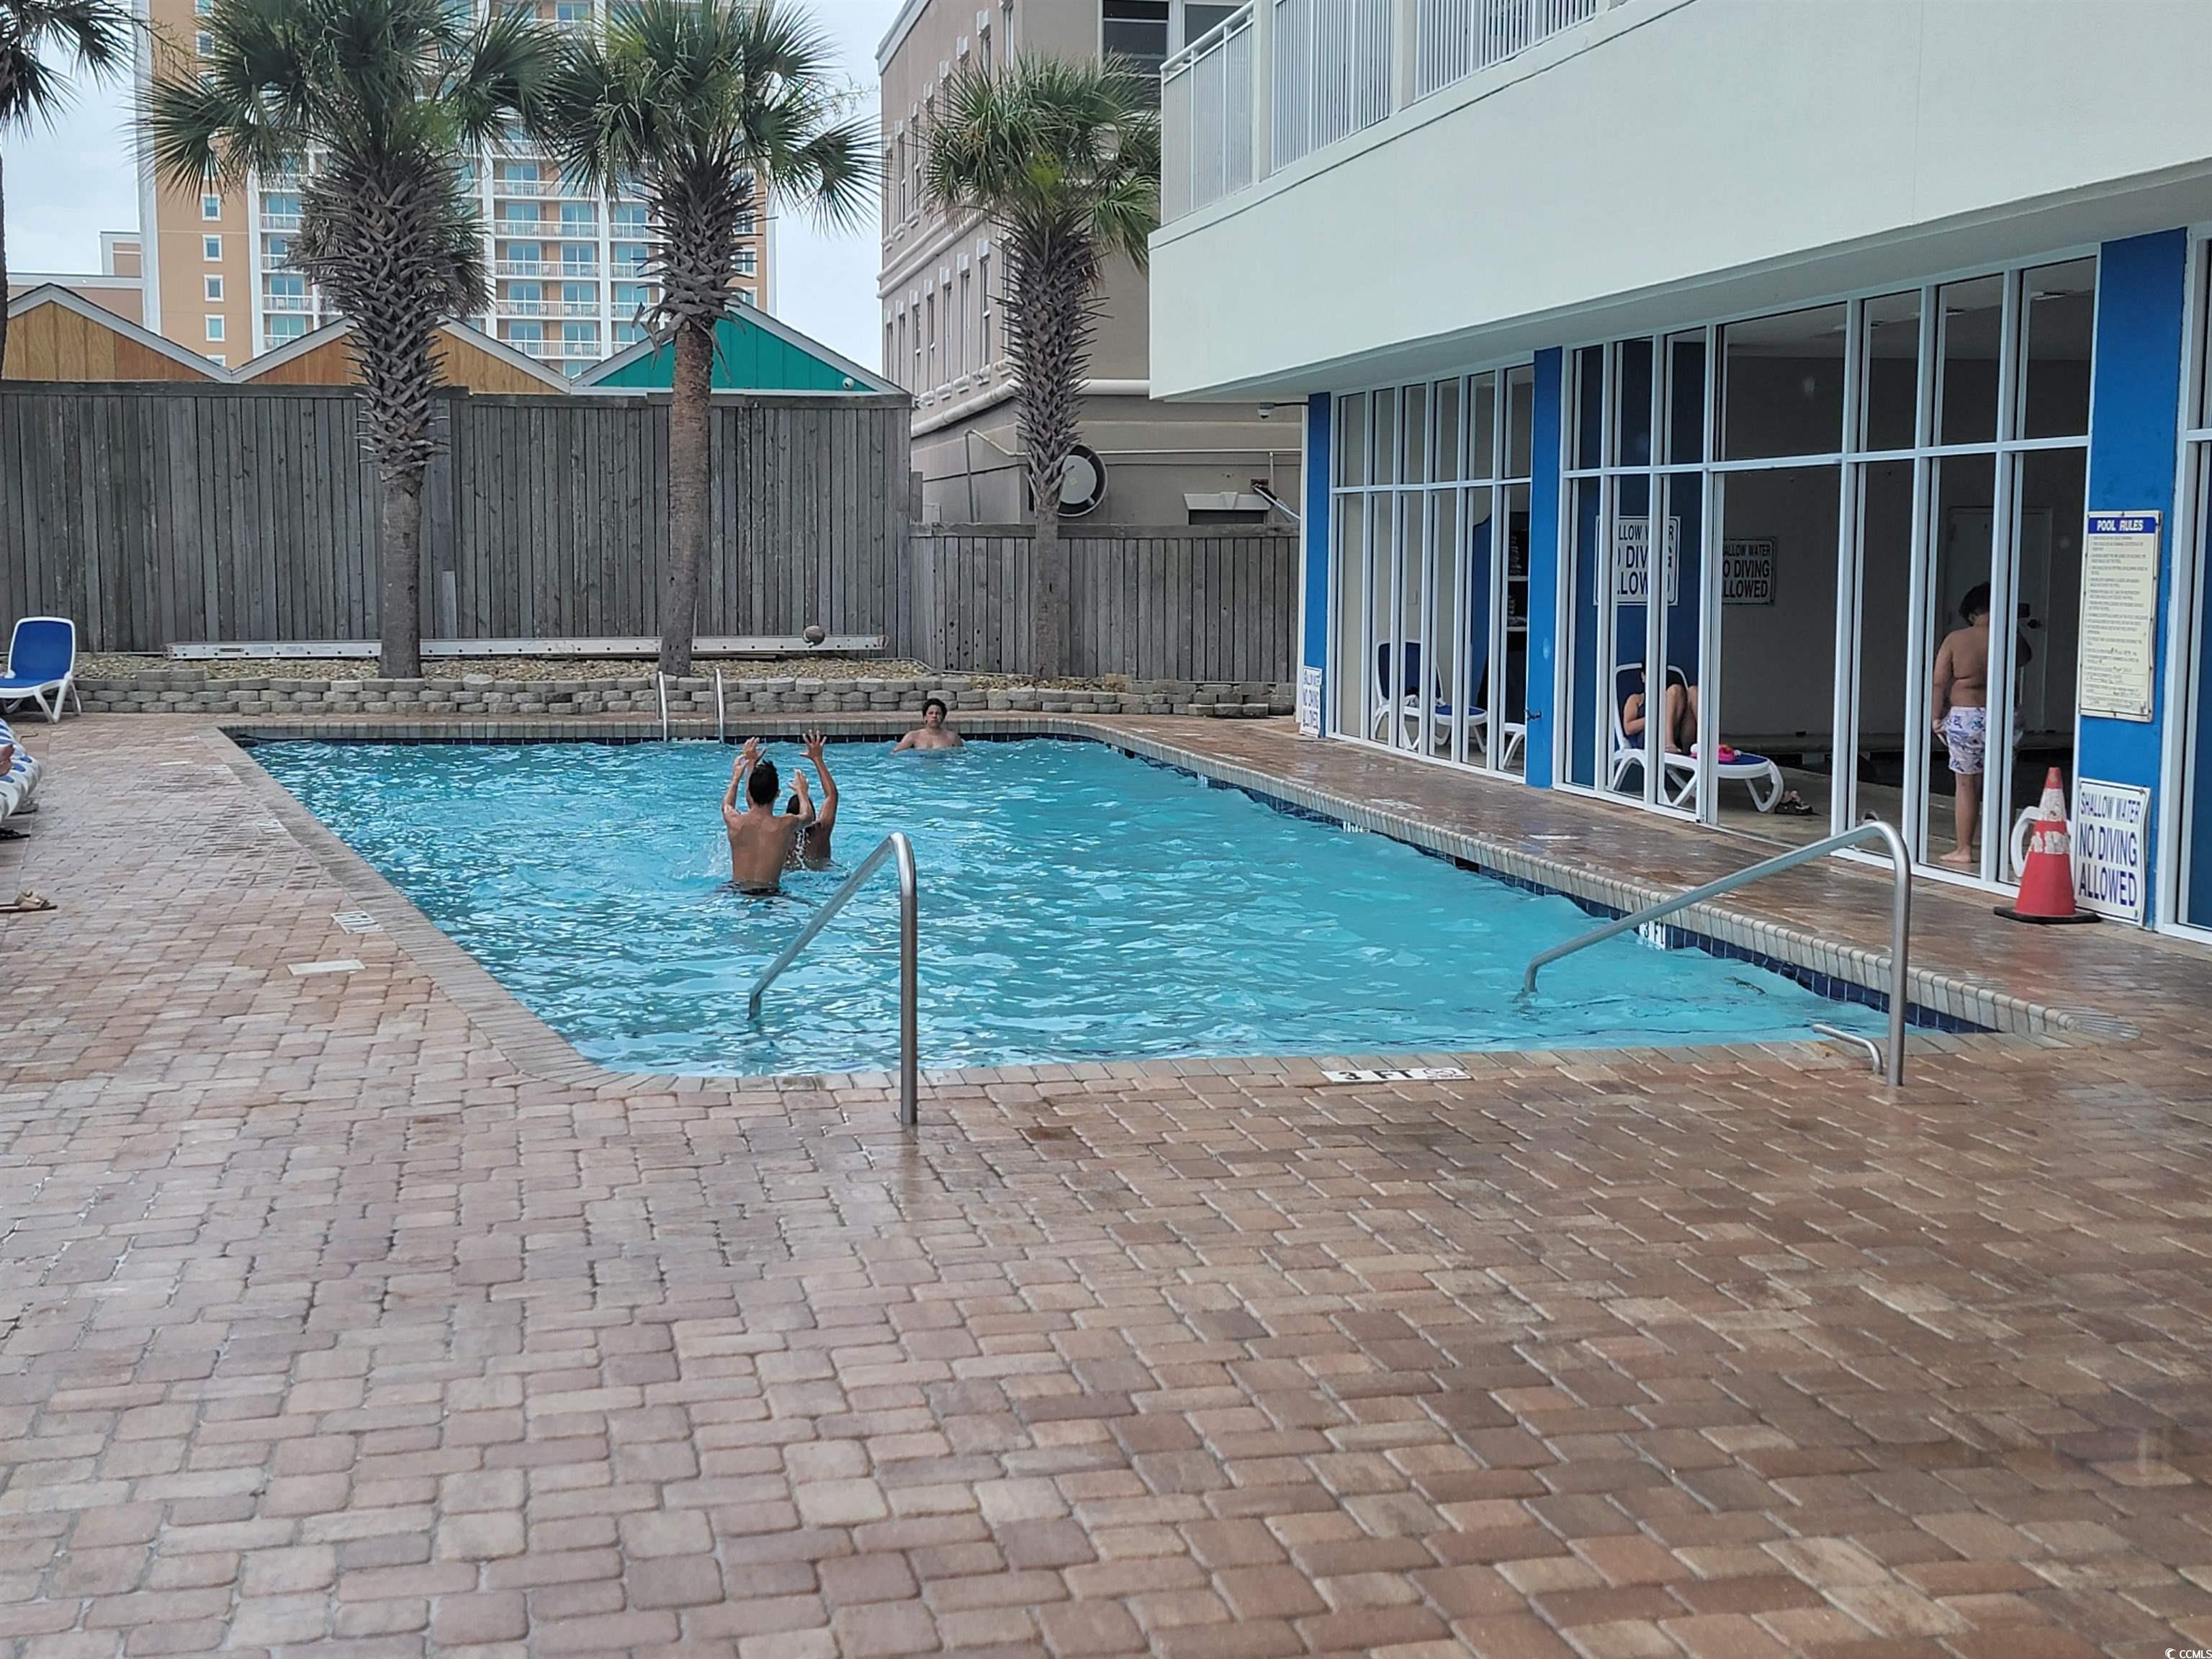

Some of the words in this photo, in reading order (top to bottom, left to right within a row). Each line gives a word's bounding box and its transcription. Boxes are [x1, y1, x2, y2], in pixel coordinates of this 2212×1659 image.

[1617, 524, 1642, 540] LLOW
[2096, 519, 2116, 531] POOL
[2119, 519, 2144, 531] RULES
[1723, 544, 1746, 557] ALLOW
[1748, 544, 1771, 557] WATER
[1723, 559, 1730, 577] O
[1734, 559, 1770, 577] DIVING
[1723, 580, 1768, 598] LLOWED
[2080, 791, 2113, 819] SHALLOW
[2116, 796, 2141, 824] WATER
[2079, 822, 2095, 858] NO
[2098, 826, 2138, 867] DIVING
[2078, 862, 2138, 907] ALLOWED
[1338, 1071, 1362, 1081] 3
[1372, 1069, 1414, 1080] FT
